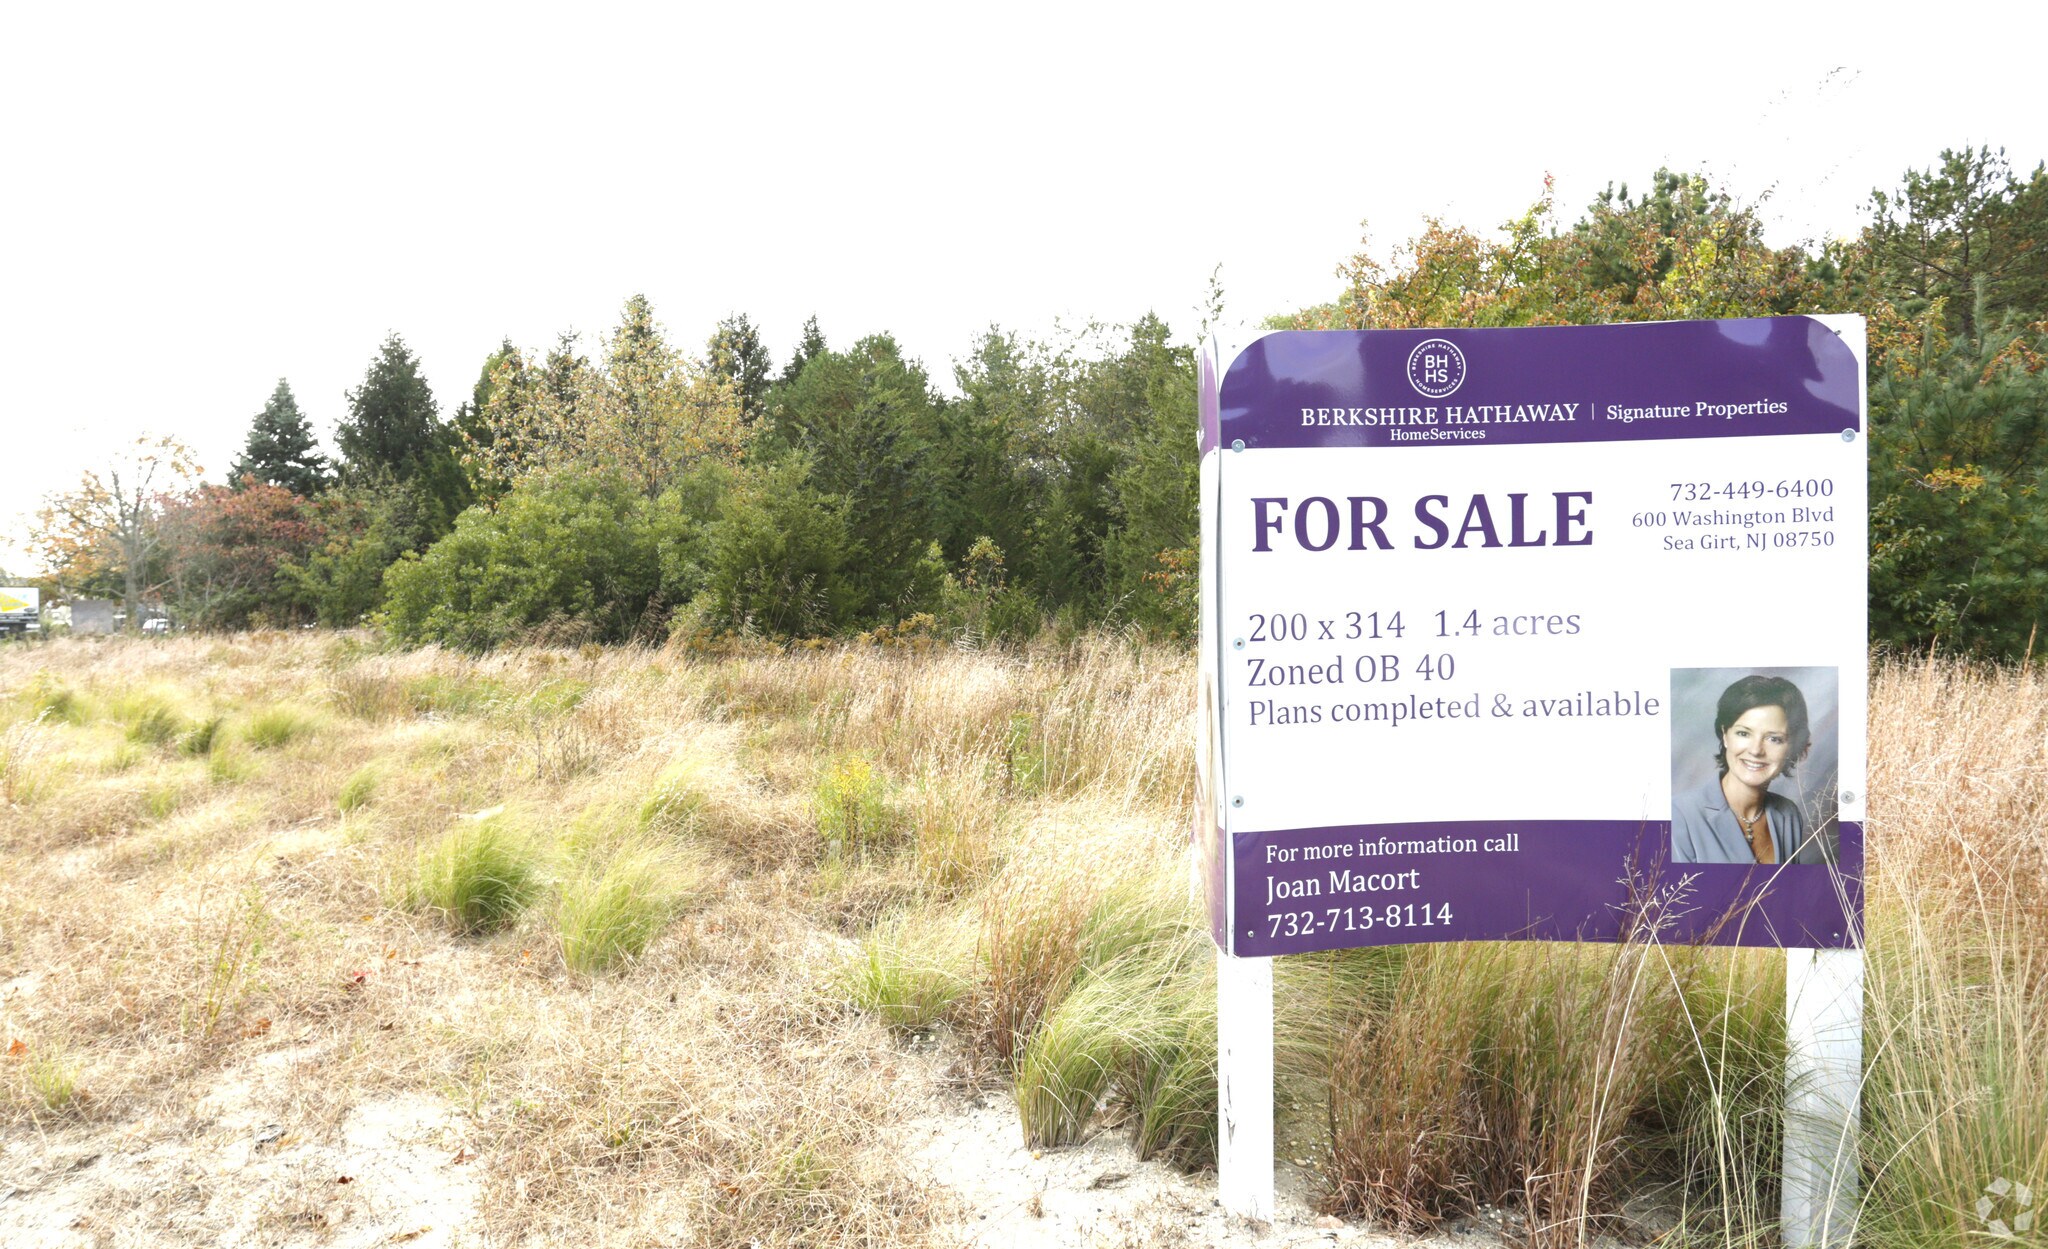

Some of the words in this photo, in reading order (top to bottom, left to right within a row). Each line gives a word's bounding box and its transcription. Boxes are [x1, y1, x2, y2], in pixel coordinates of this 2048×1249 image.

[1425, 355, 1448, 368] BH
[1425, 369, 1448, 383] HS
[1302, 407, 1438, 427] BERKSHIRE
[1446, 403, 1579, 424] HATHAWAY
[1607, 405, 1690, 423] Signature
[1696, 399, 1787, 419] Properties
[1391, 428, 1485, 440] HomeServices
[1671, 479, 1833, 501] 732-449-6400
[1251, 497, 1394, 552] FOR
[1414, 492, 1593, 549] SALE
[1633, 512, 1666, 527] 600
[1673, 510, 1785, 528] Washington
[1793, 507, 1833, 522] Blvd
[1664, 536, 1694, 550] Sea
[1701, 535, 1739, 550] Girt,
[1747, 533, 1766, 551] NJ
[1774, 531, 1834, 547] 08750
[1250, 614, 1307, 641] 200
[1318, 621, 1334, 640] x
[1346, 611, 1405, 639] 314
[1435, 610, 1481, 636] 1.4
[1493, 615, 1580, 635] acres
[1248, 655, 1343, 686] Zoned
[1356, 655, 1399, 682] OB
[1416, 654, 1454, 680] 40
[1250, 700, 1321, 725] Plans
[1332, 693, 1480, 727] completed
[1492, 694, 1513, 717] &
[1523, 691, 1659, 717] available
[1266, 845, 1298, 863] For
[1304, 844, 1353, 860] more
[1359, 836, 1477, 856] information
[1484, 834, 1519, 851] call
[1267, 876, 1321, 905] Joan
[1329, 869, 1420, 894] Macort
[1266, 901, 1452, 937] 732-713-8114
